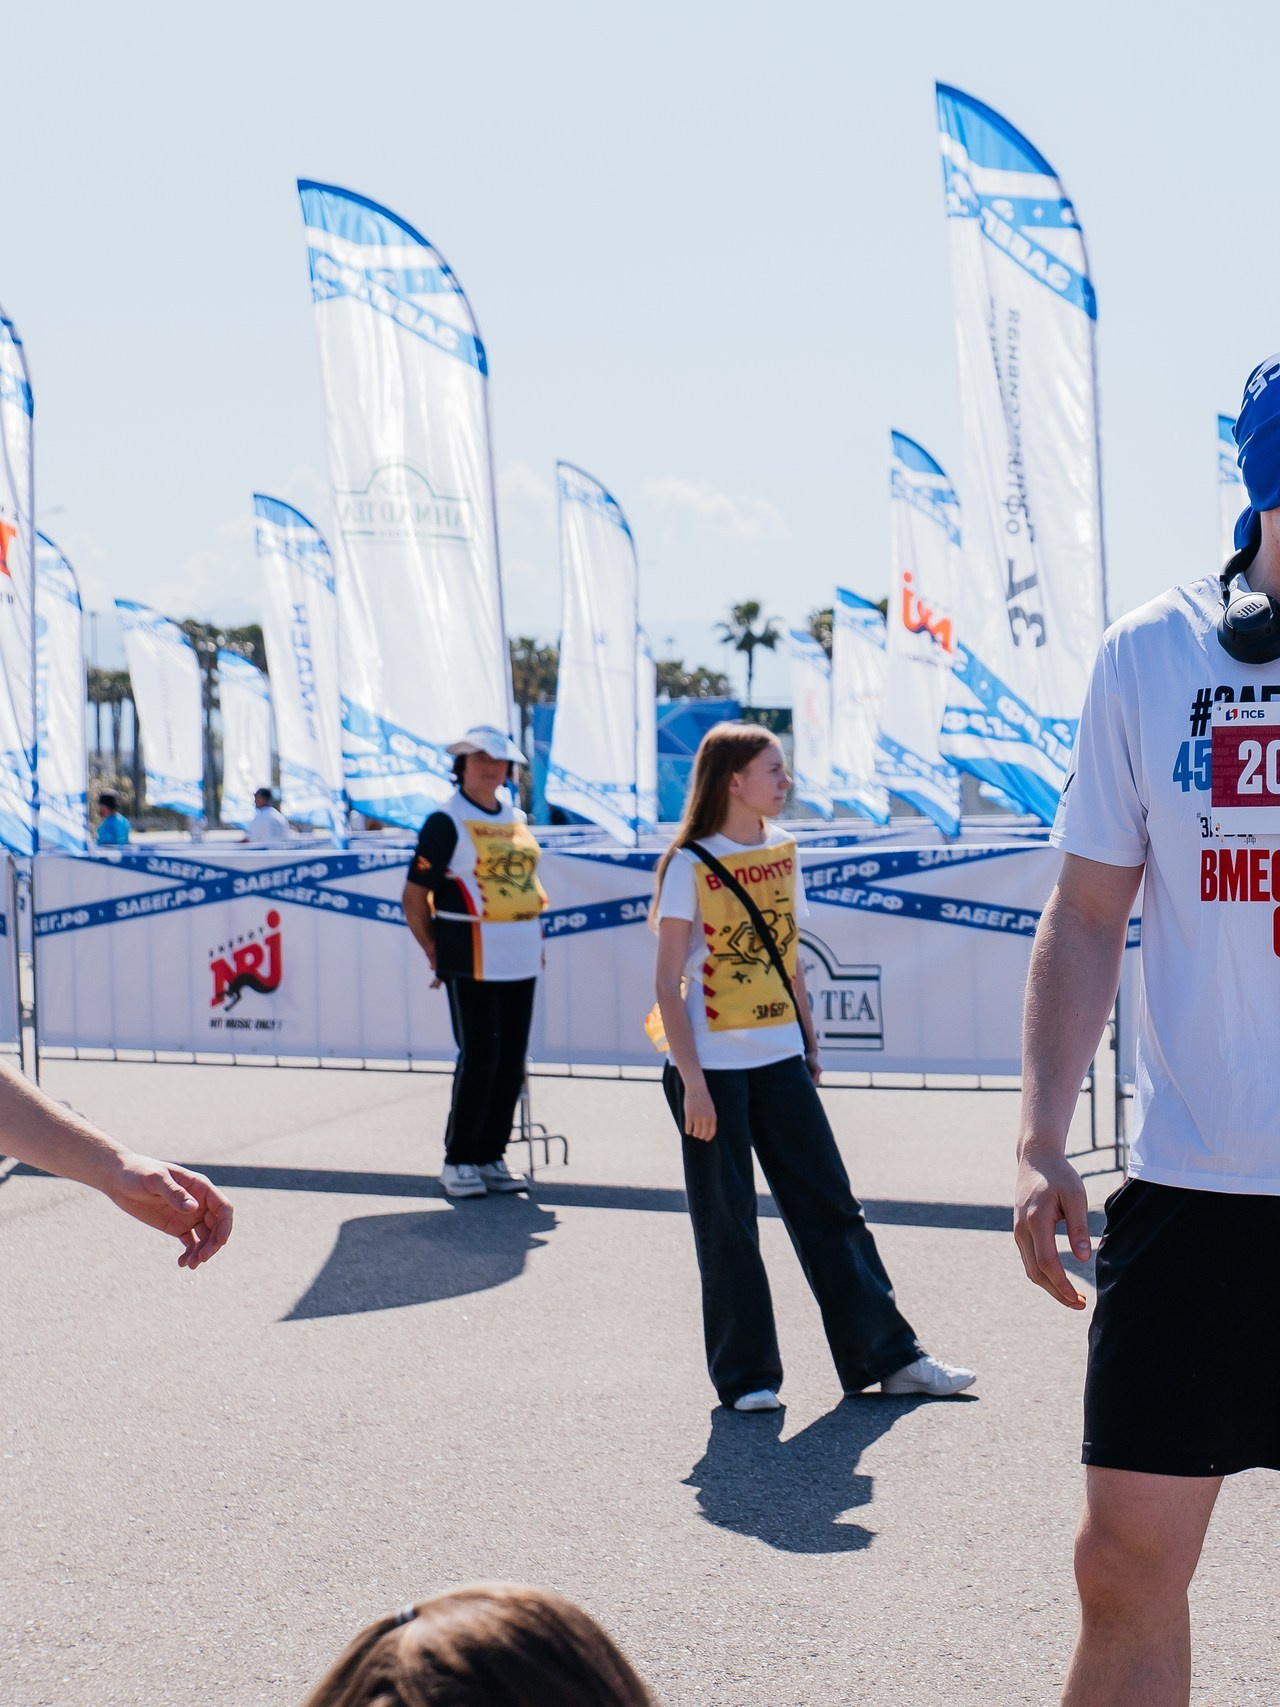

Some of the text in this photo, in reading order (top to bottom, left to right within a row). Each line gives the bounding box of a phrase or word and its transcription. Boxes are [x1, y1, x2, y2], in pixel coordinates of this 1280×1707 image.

[1237, 602, 1263, 618] JBL
[1241, 709, 1265, 719] ПСБ
[115, 887, 206, 917] ЗАБЕГ.РФ
[233, 862, 329, 895] ЗАБЕГ.РФ
[940, 902, 1040, 930] ЗАБЕГ.Р
[820, 990, 875, 1022] TEA
